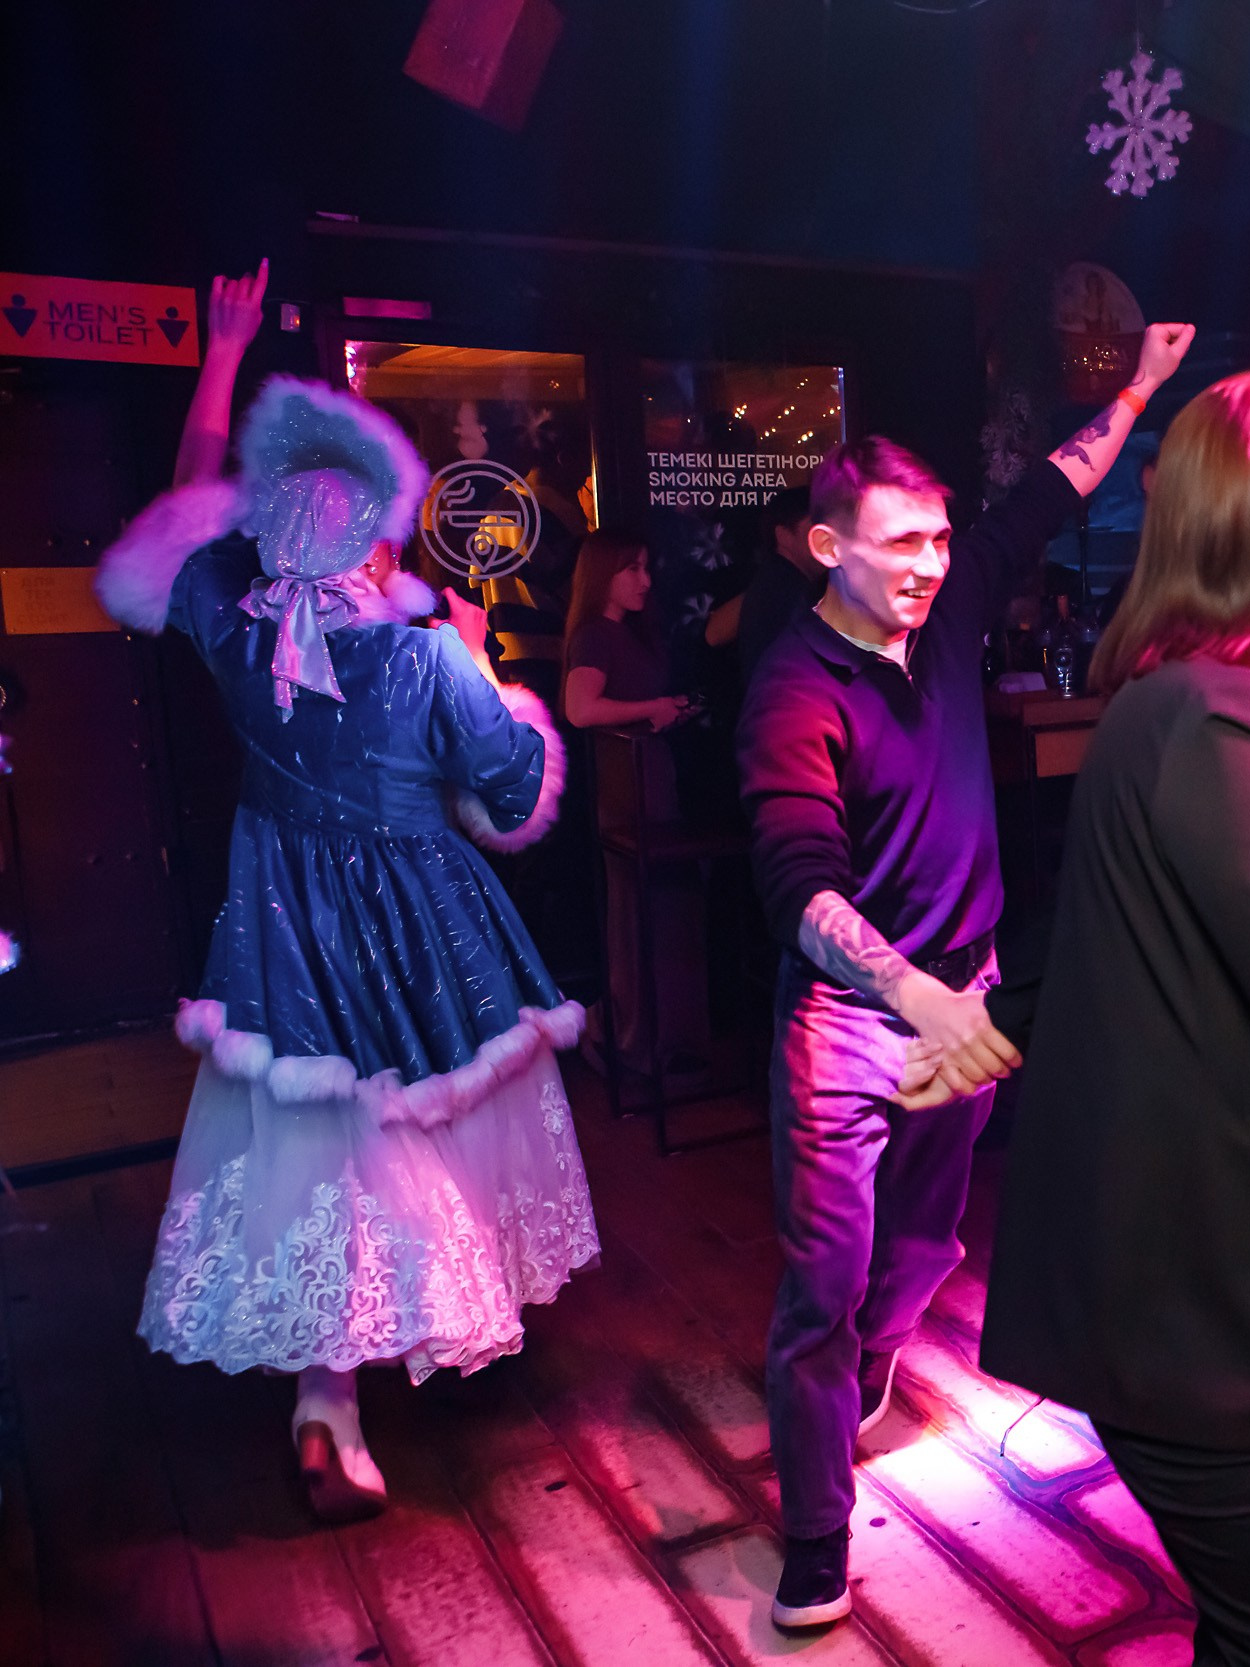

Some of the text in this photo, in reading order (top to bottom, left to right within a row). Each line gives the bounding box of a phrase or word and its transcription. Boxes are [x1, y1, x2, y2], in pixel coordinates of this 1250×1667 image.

[48, 300, 147, 326] MEN'S
[43, 321, 154, 347] TOILET
[647, 452, 713, 468] ТЕМЕКІ
[648, 471, 787, 487] SMOKING AREA
[650, 491, 715, 506] МЕСТО
[719, 491, 758, 508] ДЛЯ
